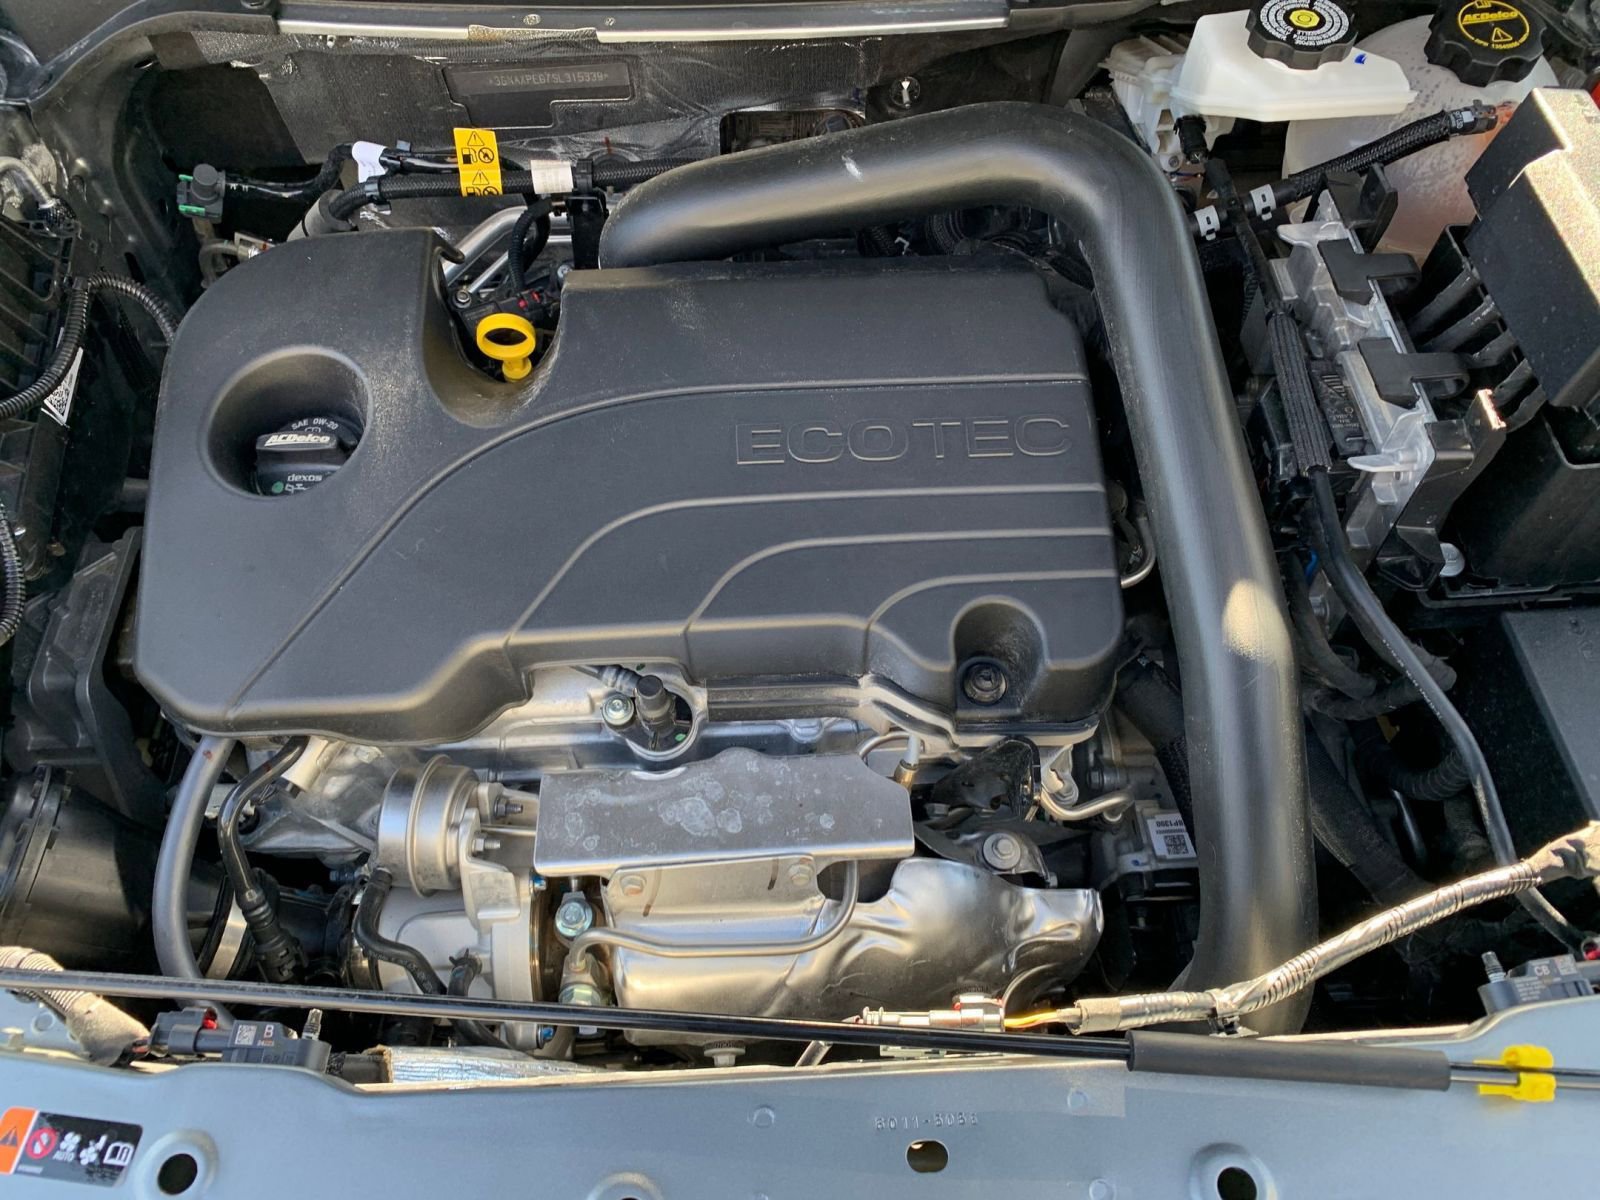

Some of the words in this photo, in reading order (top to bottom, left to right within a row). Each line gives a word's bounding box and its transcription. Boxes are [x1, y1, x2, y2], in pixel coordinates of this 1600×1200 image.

[1462, 11, 1519, 25] ACDelco
[291, 418, 309, 431] SAE
[312, 417, 339, 431] 0W-20
[264, 433, 331, 447] ACDelco
[735, 413, 1073, 465] ECOTEC
[287, 473, 323, 482] dexos
[1534, 964, 1551, 976] CB
[263, 1024, 275, 1039] B
[53, 1150, 76, 1163] AUTO
